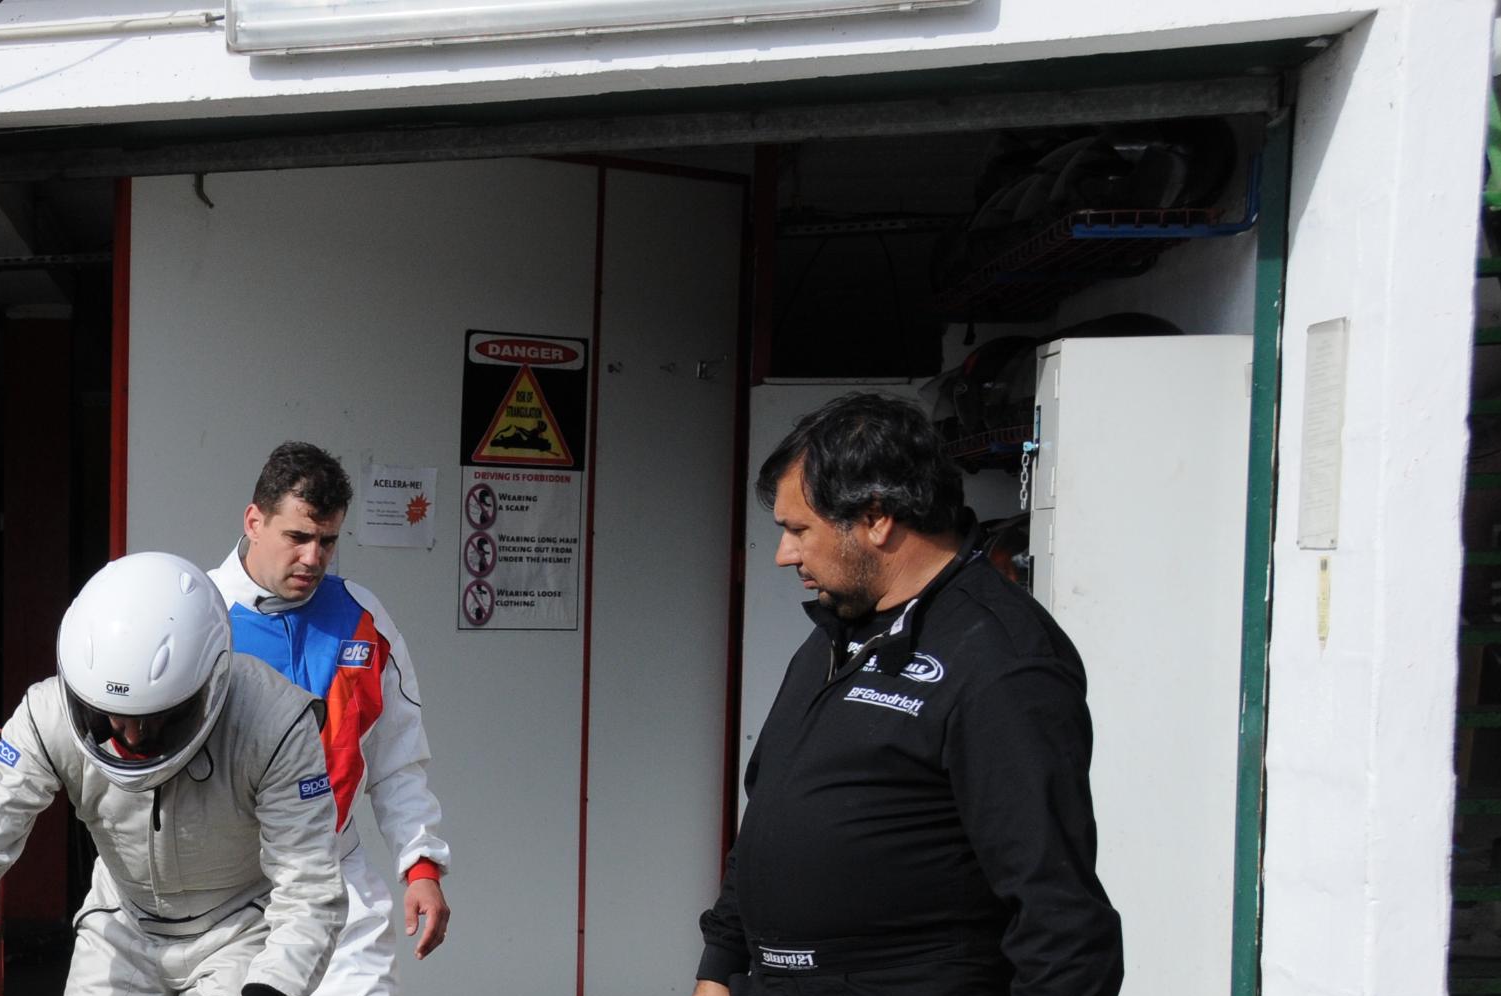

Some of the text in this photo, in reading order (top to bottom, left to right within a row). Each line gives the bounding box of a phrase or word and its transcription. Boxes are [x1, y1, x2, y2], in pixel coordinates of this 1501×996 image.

[488, 343, 564, 361] DANGER
[474, 471, 572, 484] DRIVING IS FORBIDDEN
[498, 493, 538, 502] WEARING
[498, 534, 536, 544] WEARING
[541, 557, 571, 565] HELMET
[496, 588, 561, 598] WEARING LOOSE
[496, 600, 535, 608] CLOTHING
[106, 682, 130, 695] OMP
[847, 687, 924, 712] BFGoodrich
